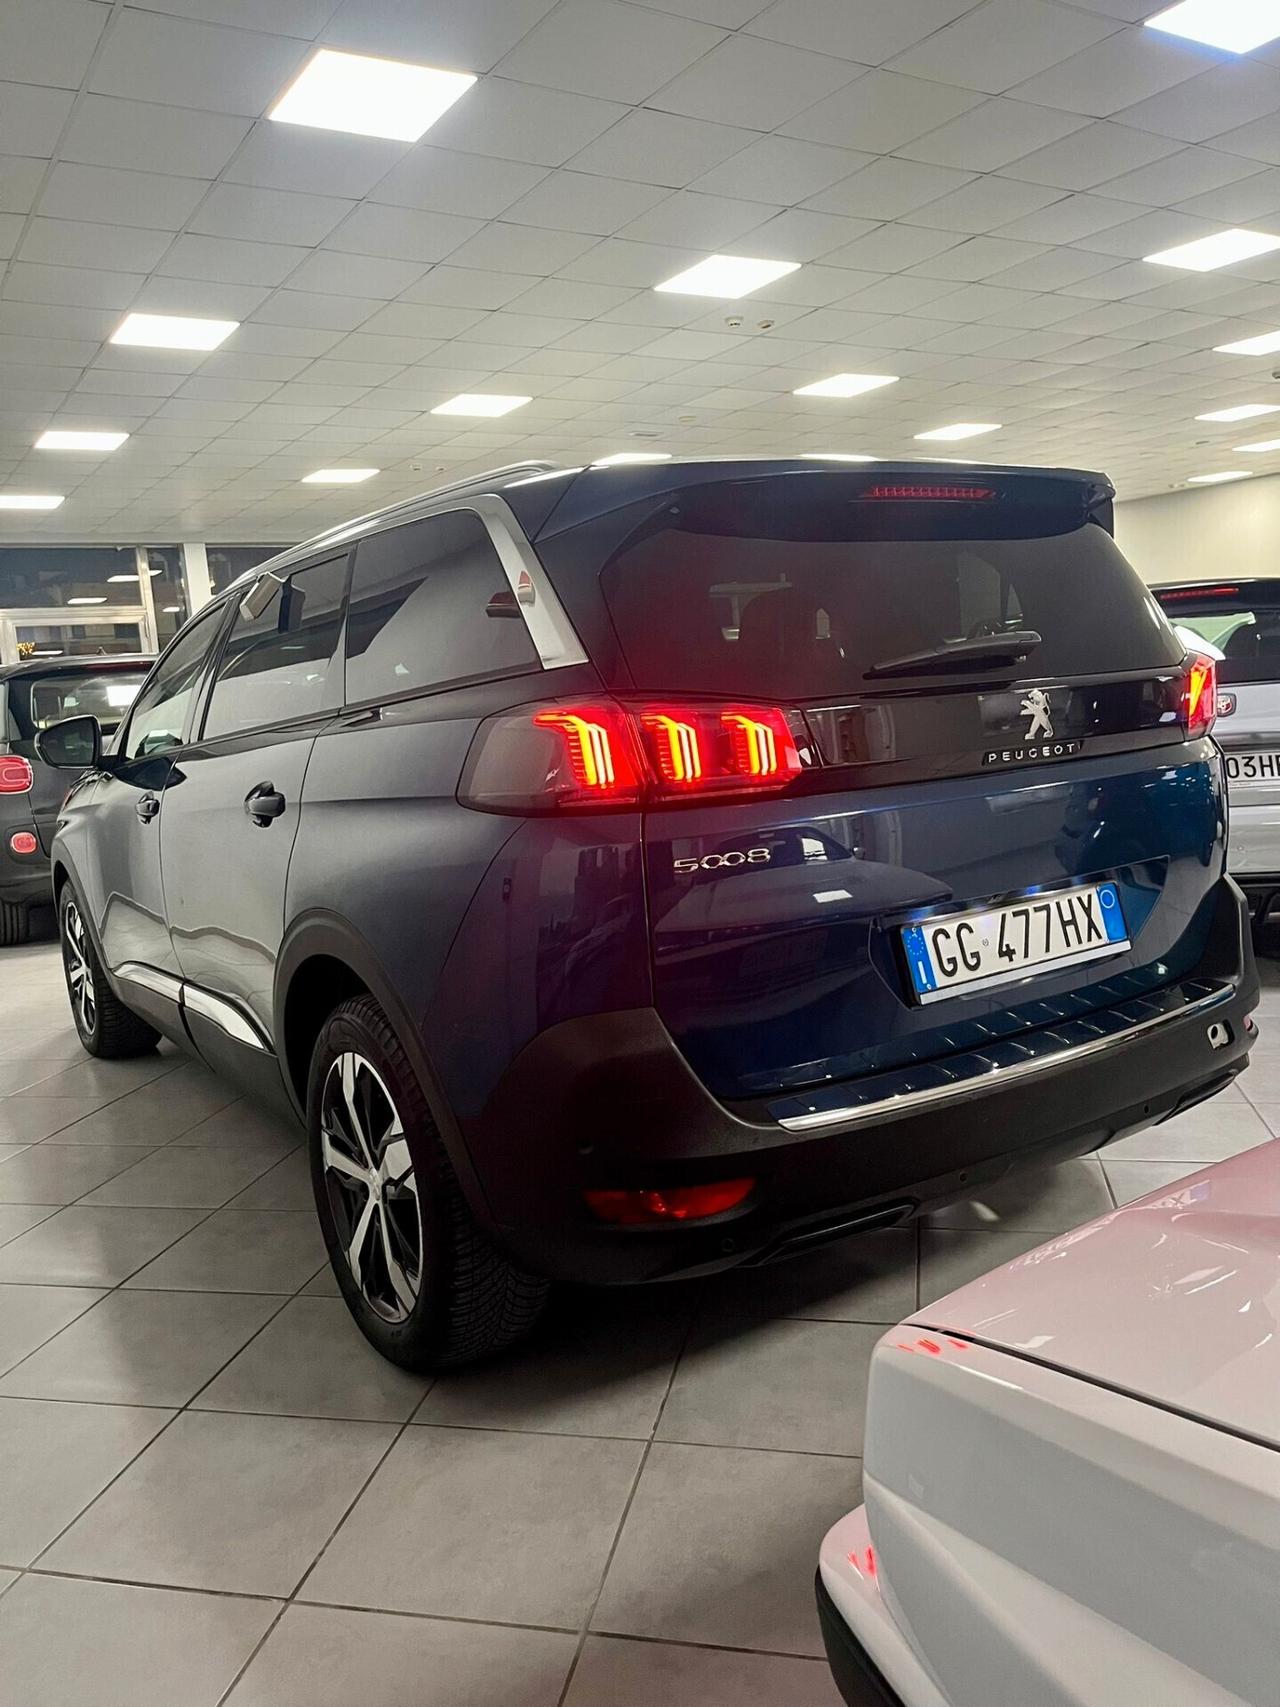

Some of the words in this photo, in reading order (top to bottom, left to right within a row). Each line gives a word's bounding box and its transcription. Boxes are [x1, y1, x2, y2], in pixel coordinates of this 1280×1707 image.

[988, 743, 1075, 763] PEUGEOT
[674, 848, 771, 873] 5008
[932, 922, 981, 978] GG
[998, 893, 1103, 963] 477HX
